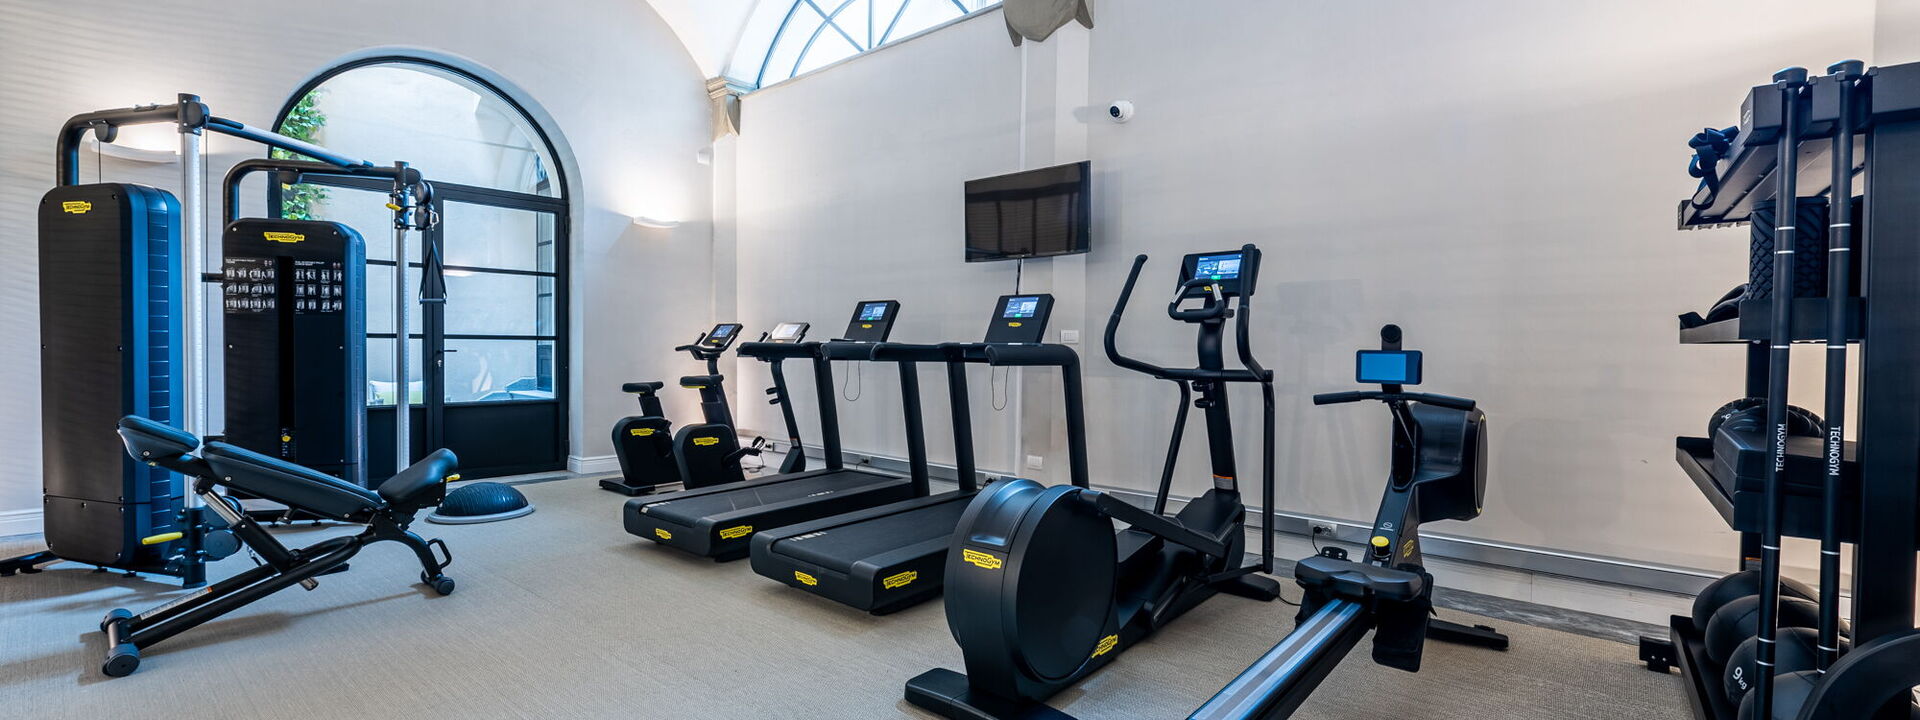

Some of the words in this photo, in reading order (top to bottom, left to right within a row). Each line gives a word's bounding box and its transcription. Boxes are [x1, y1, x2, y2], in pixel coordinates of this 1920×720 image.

[1775, 423, 1786, 472] TECHNOGYM
[1828, 426, 1841, 476] TECHNOGYM
[964, 552, 1001, 567] TECHNOGYM
[884, 571, 917, 588] TECHNOGYM
[1732, 666, 1743, 680] 9
[1738, 677, 1747, 690] kg
